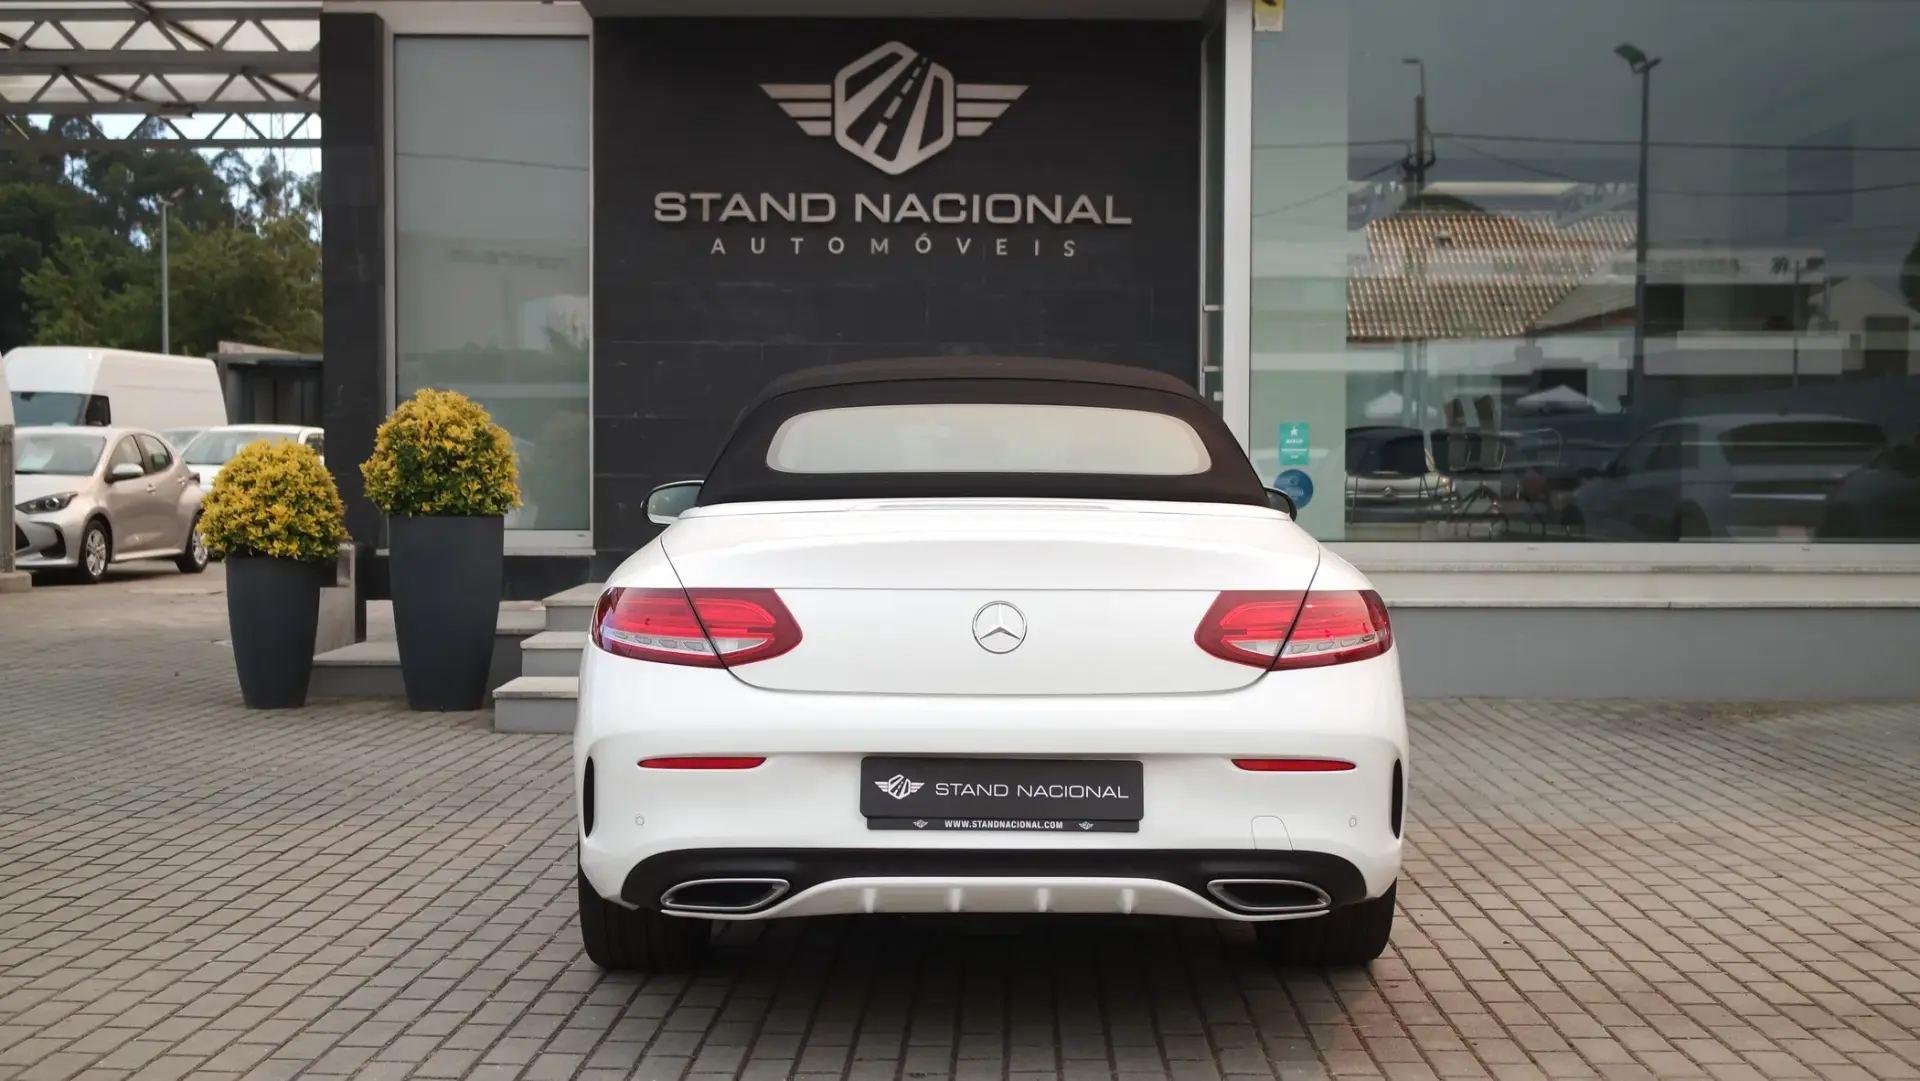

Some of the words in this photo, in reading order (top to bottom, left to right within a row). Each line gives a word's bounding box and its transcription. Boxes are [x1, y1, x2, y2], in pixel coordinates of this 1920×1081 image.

[654, 192, 836, 223] STAND
[854, 193, 1132, 225] NACIONAL
[935, 782, 1008, 797] STAND
[1017, 784, 1129, 799] NACIONAL
[944, 819, 1063, 830] WWW.STANDNACIONAL.COM
